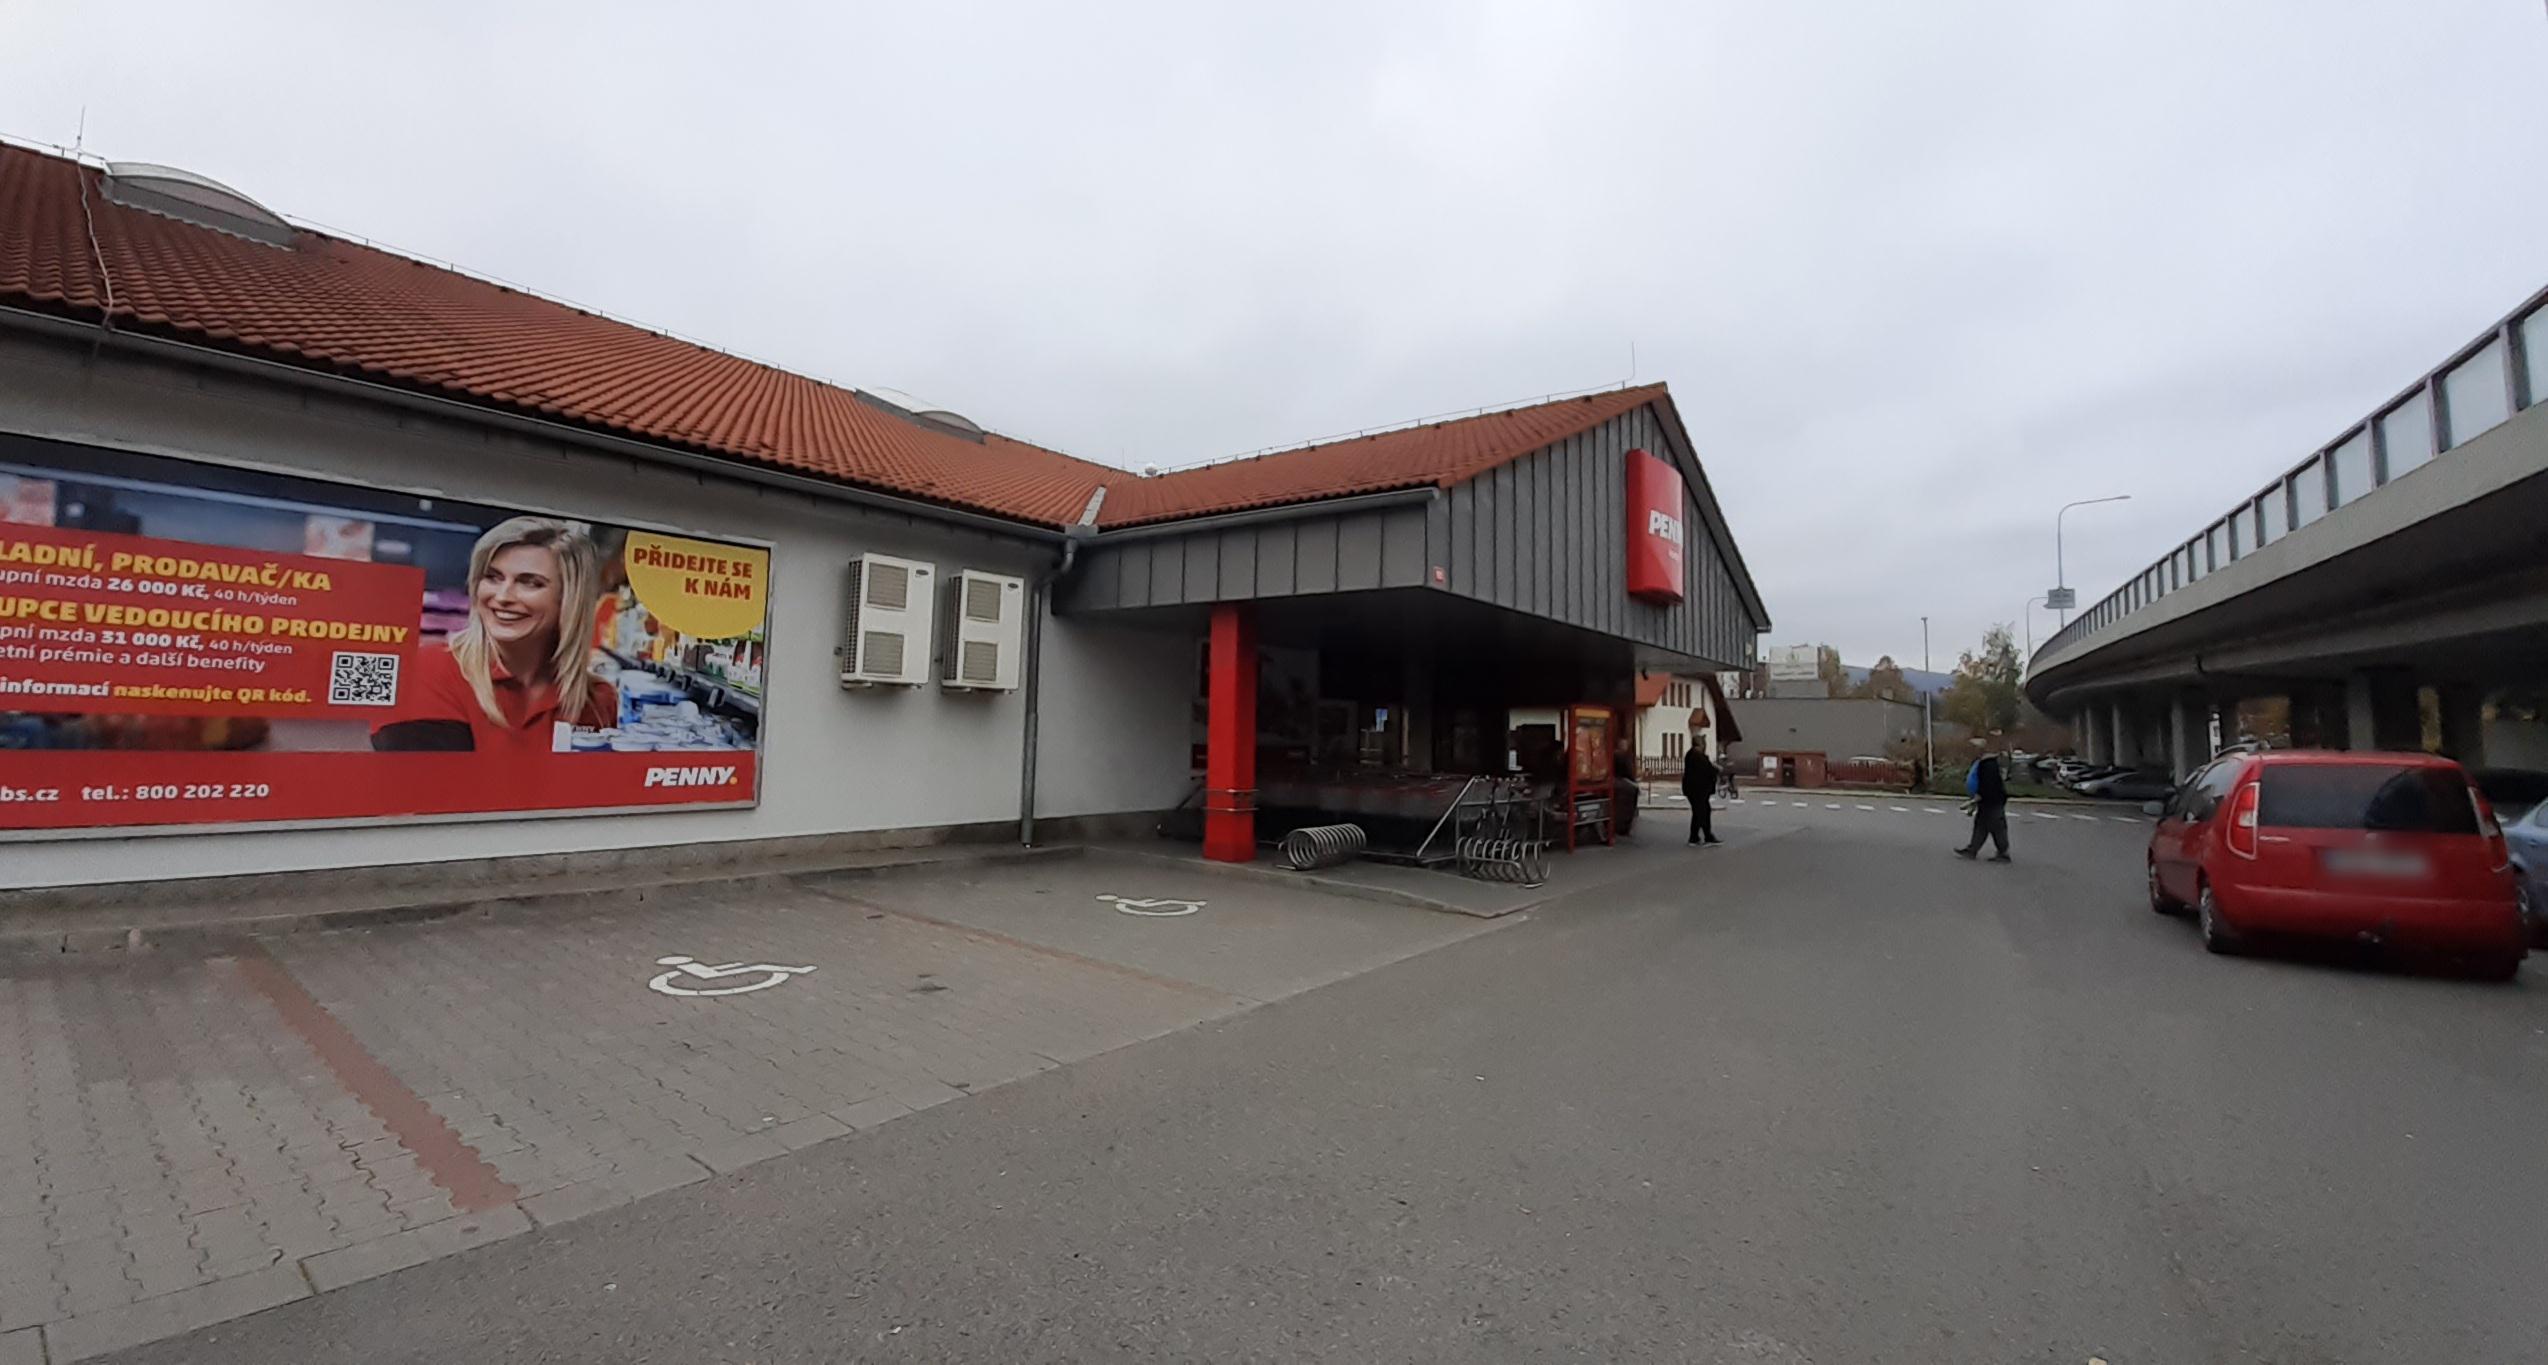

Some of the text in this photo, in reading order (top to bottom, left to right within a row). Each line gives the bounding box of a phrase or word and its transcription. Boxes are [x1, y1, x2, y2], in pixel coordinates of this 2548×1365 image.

[111, 552, 332, 591] PRODAVAČ/KA
[634, 544, 752, 579] PŘIDEJTE SE
[45, 573, 102, 589] mzda
[107, 577, 134, 592] 26
[138, 580, 177, 596] 000
[181, 584, 210, 600] Kč,
[214, 588, 234, 600] 40
[237, 590, 297, 606] h/týden
[684, 577, 751, 600] K NÁM
[0, 596, 408, 643] UPCE VEDOUCÍHO PRODEJNY
[39, 627, 96, 643] mzda
[101, 630, 127, 645] 31
[132, 632, 171, 647] 000
[176, 635, 204, 651] Kč,
[209, 640, 228, 650] 40
[232, 640, 293, 655] h/týden
[40, 646, 114, 663] prémie
[119, 653, 131, 664] a
[136, 650, 184, 666] další
[187, 654, 266, 673] benefity
[0, 676, 312, 703] informací naskenujte QR kód.
[0, 783, 269, 801] bs.cz tel.: 800 202 220
